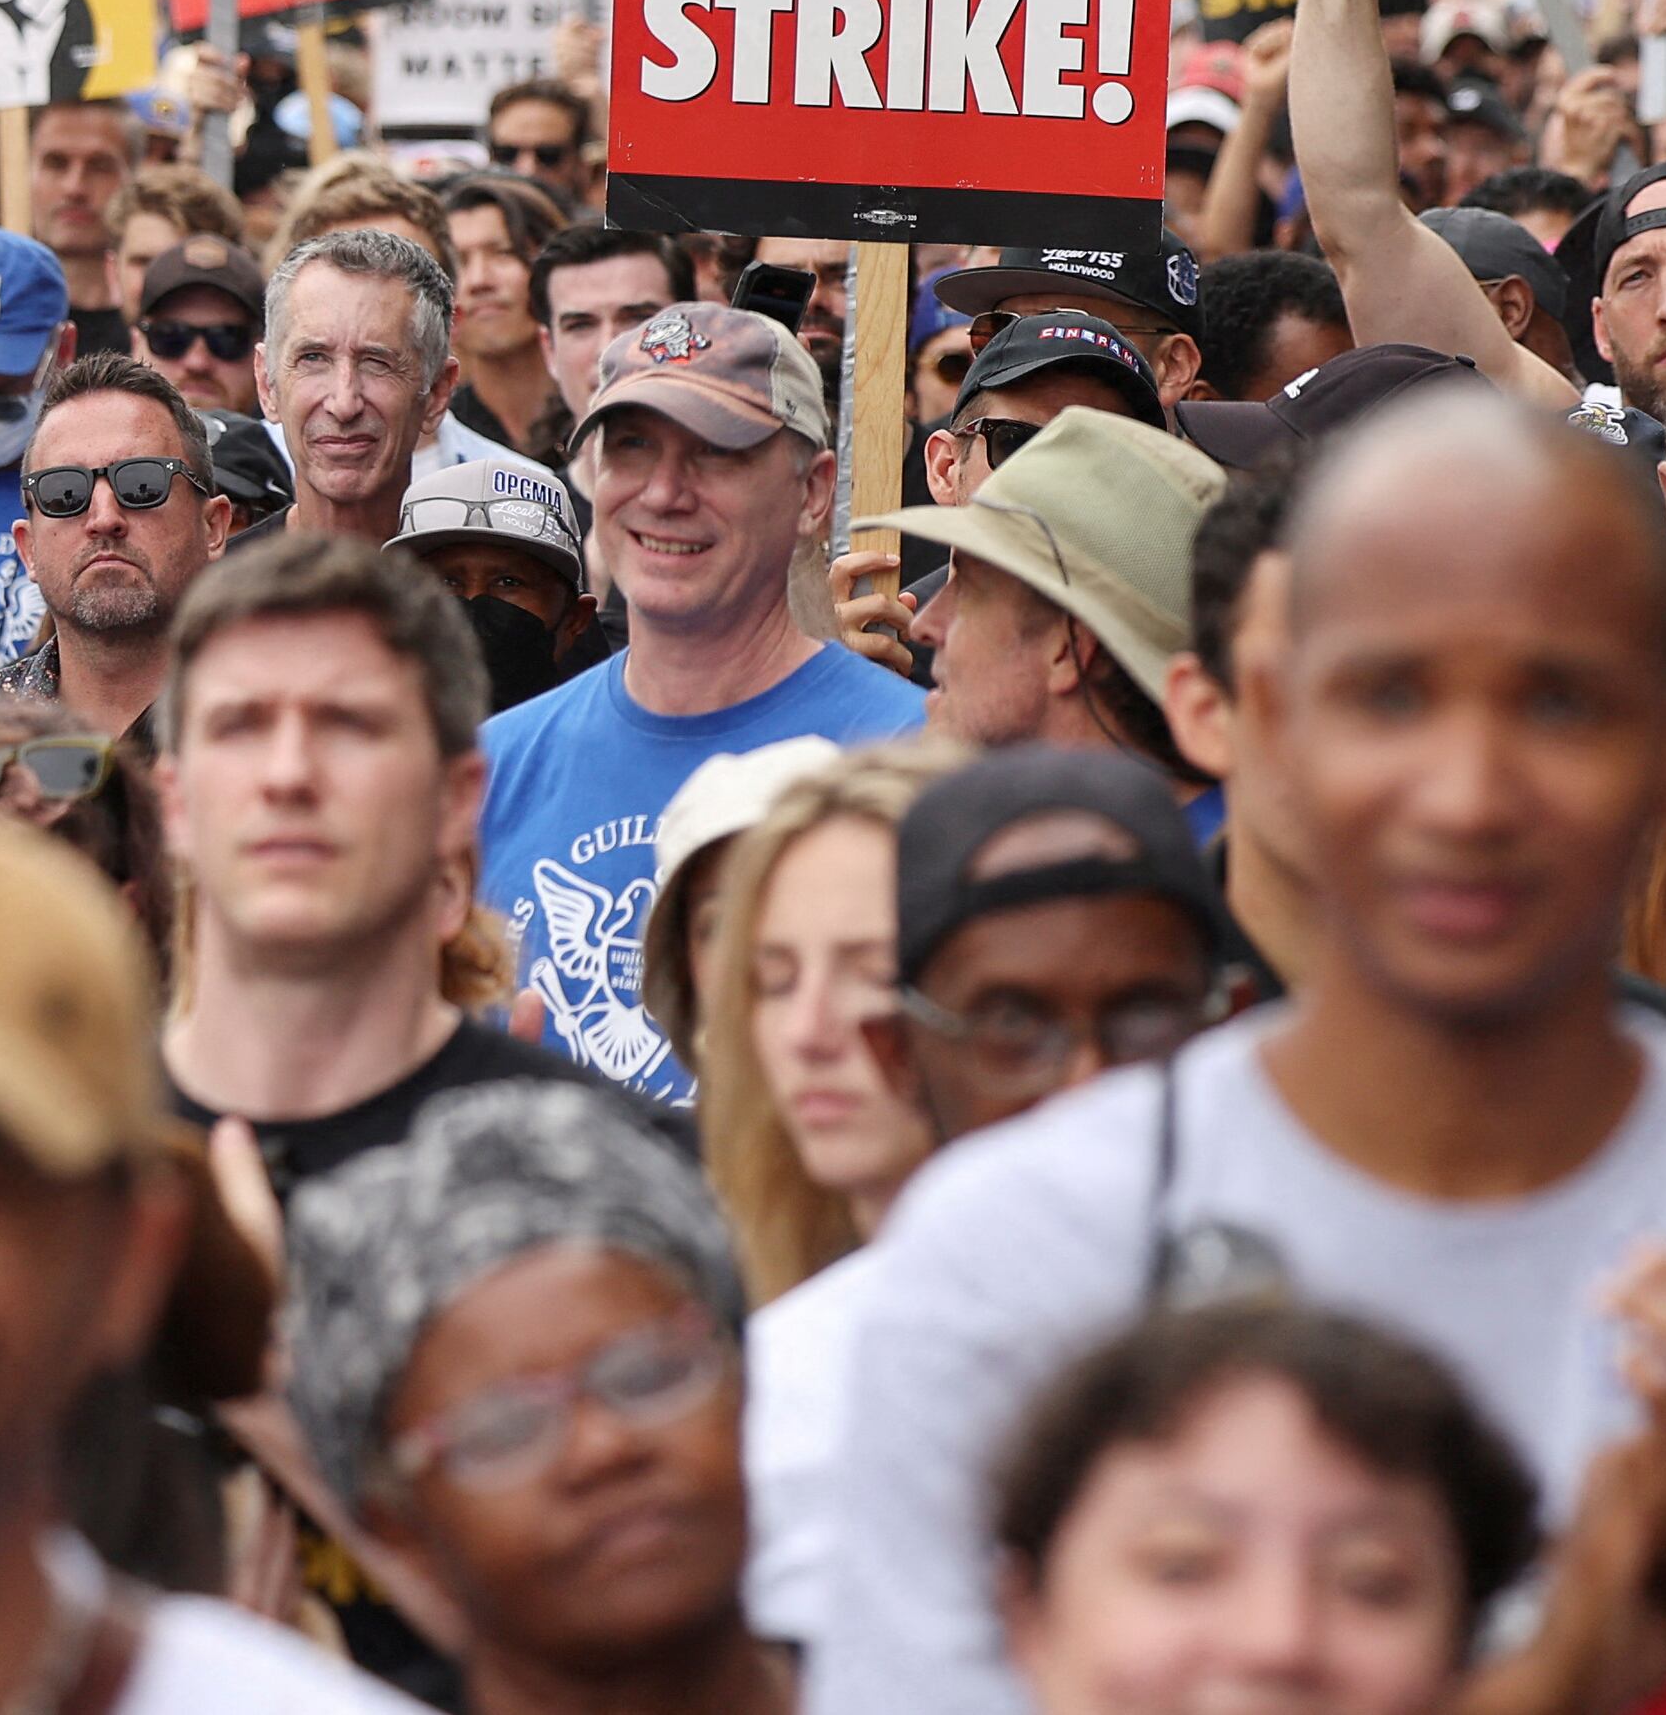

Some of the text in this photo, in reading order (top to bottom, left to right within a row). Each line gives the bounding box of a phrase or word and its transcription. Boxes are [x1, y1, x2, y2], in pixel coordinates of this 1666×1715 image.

[1048, 262, 1116, 282] HOLLYWOOD
[493, 469, 562, 516] OPCMIA
[492, 500, 538, 518] Local
